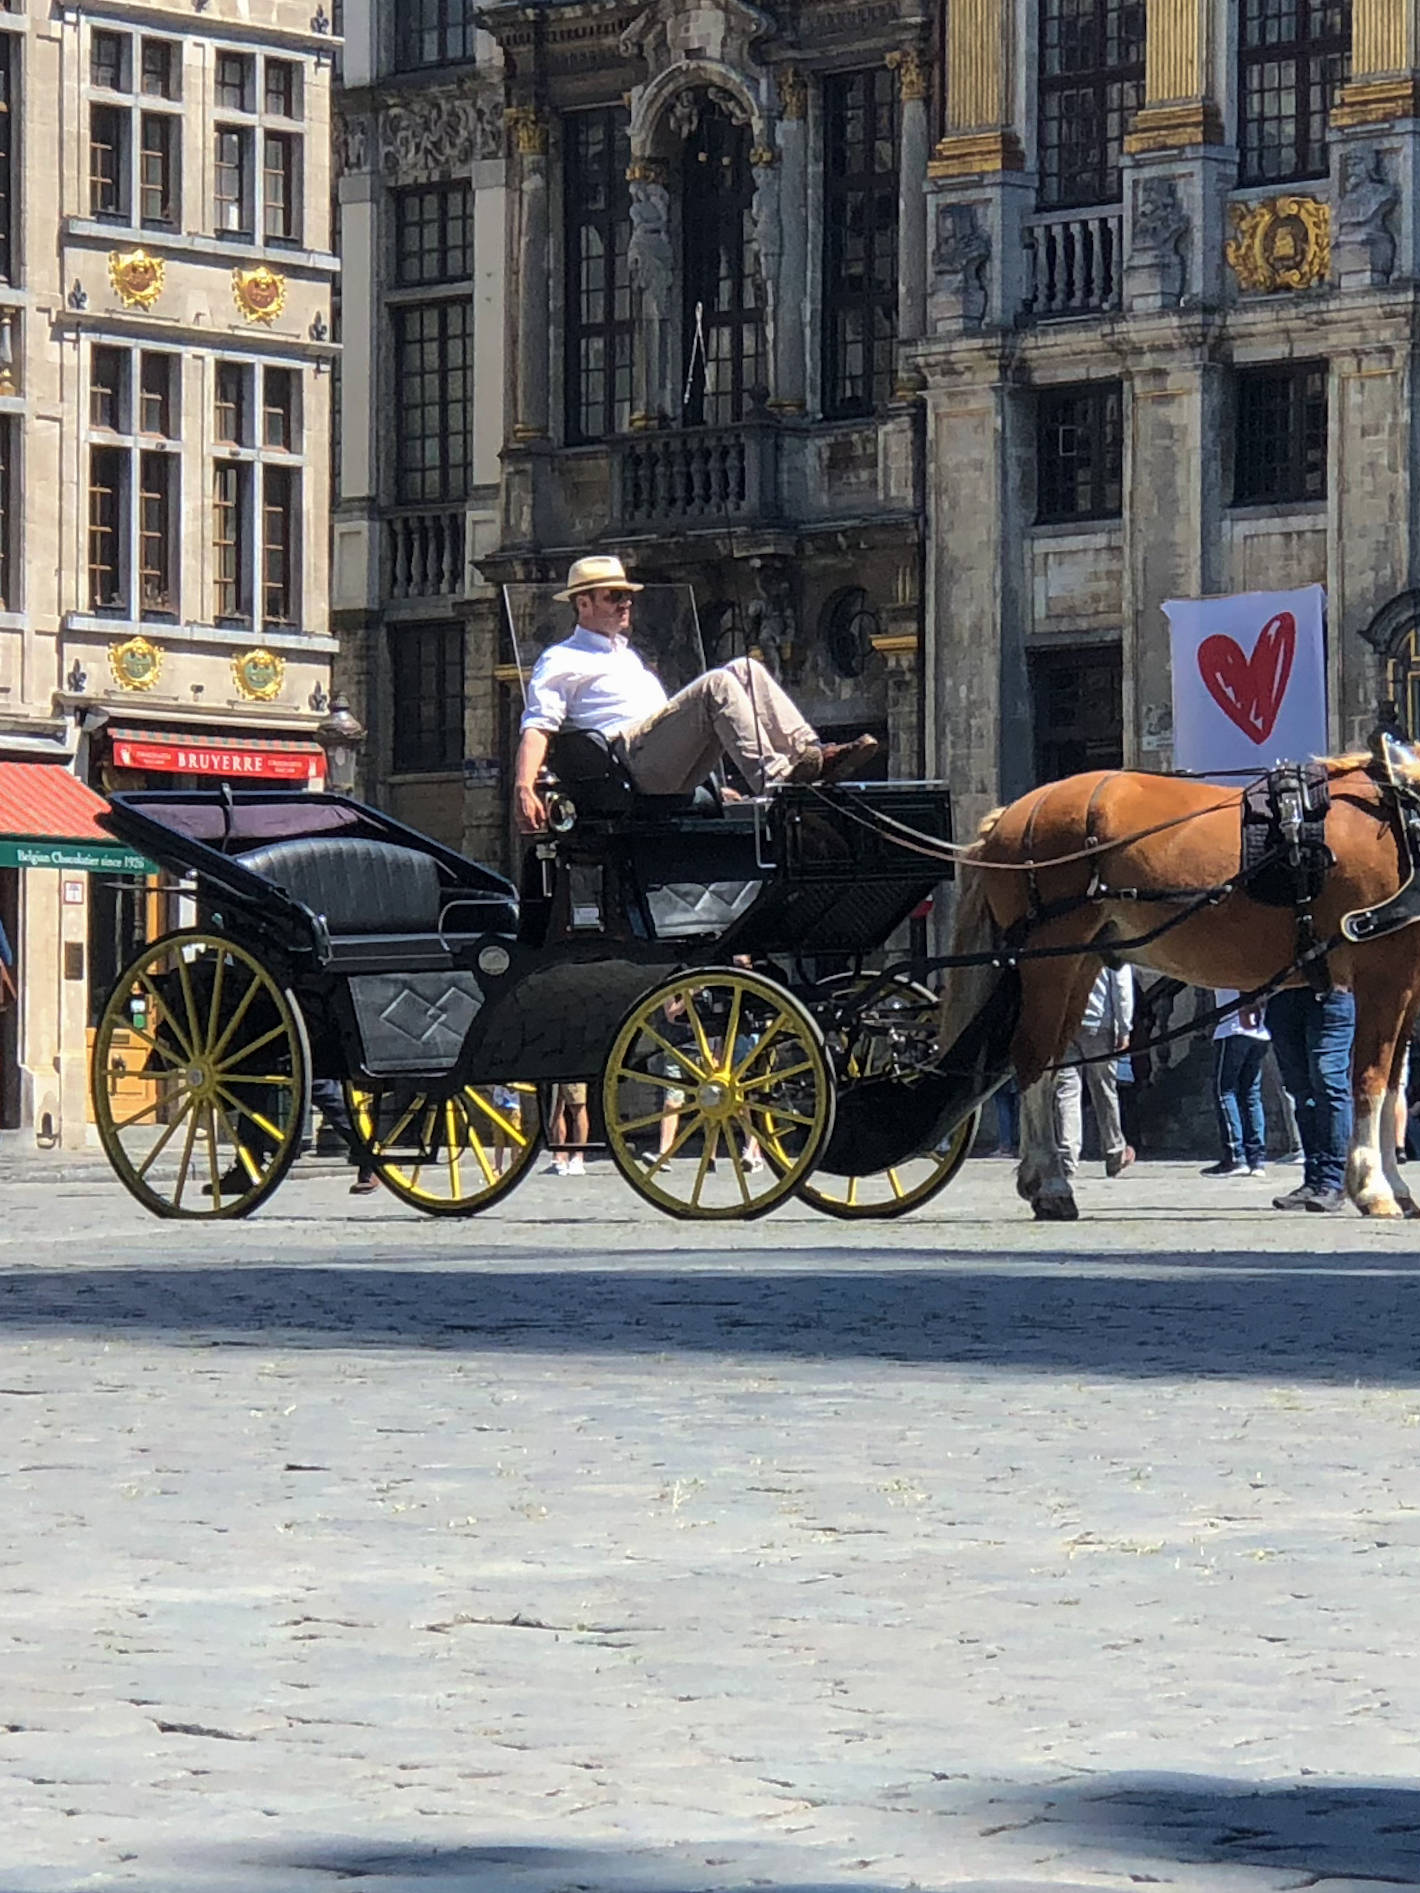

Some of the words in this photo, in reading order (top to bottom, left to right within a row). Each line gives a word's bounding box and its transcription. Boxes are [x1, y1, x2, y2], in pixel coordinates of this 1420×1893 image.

[177, 752, 263, 772] BRUYERRE
[17, 849, 50, 865] Belgian
[51, 851, 99, 866] Chocolatier
[101, 854, 122, 868] since
